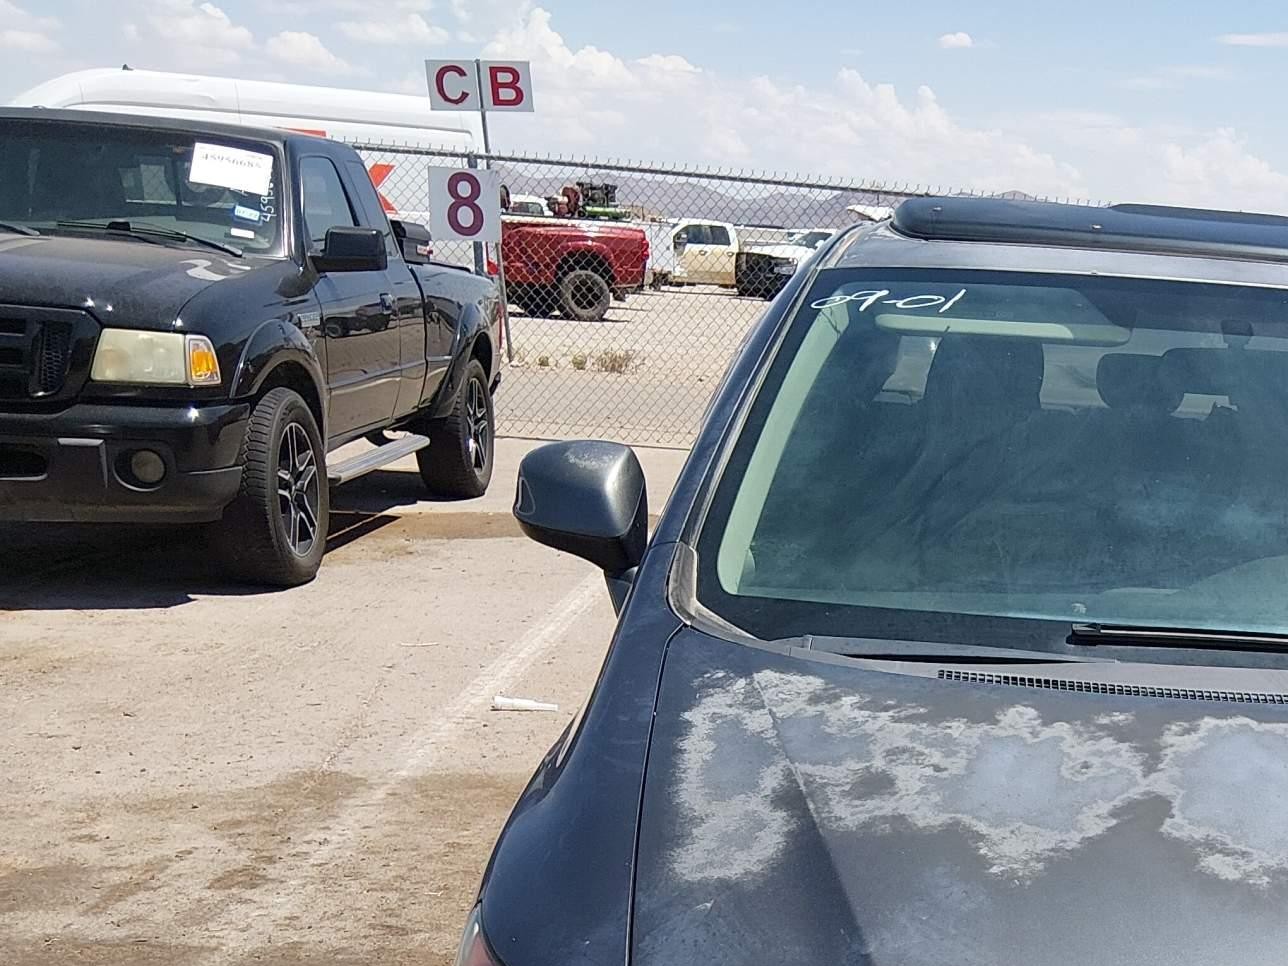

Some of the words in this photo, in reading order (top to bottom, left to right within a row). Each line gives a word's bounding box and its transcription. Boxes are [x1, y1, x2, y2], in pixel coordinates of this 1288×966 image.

[435, 65, 470, 105] C
[489, 66, 524, 106] B
[447, 171, 484, 237] 8
[811, 288, 967, 313] 09-01
